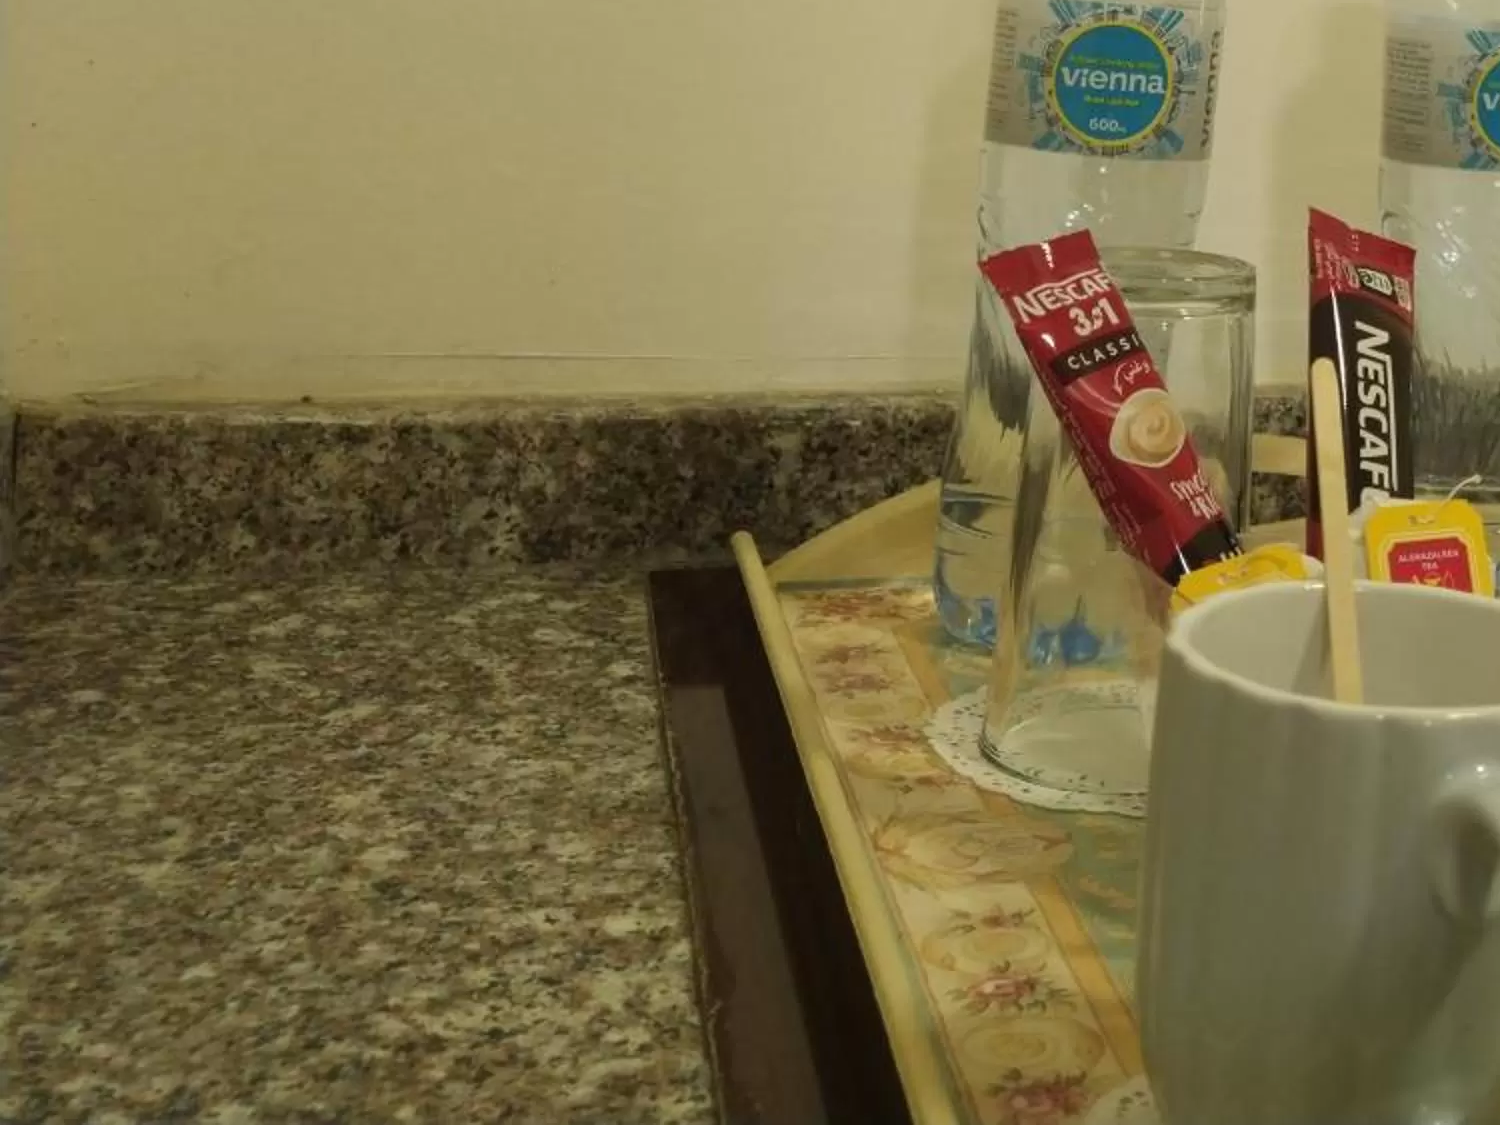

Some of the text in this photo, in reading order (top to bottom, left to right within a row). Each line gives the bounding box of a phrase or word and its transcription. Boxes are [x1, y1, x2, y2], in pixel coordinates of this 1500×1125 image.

[1060, 66, 1165, 94] vienna
[1013, 268, 1113, 324] NESCAF
[1066, 336, 1141, 371] CLASSI
[1353, 320, 1398, 491] NESCAF
